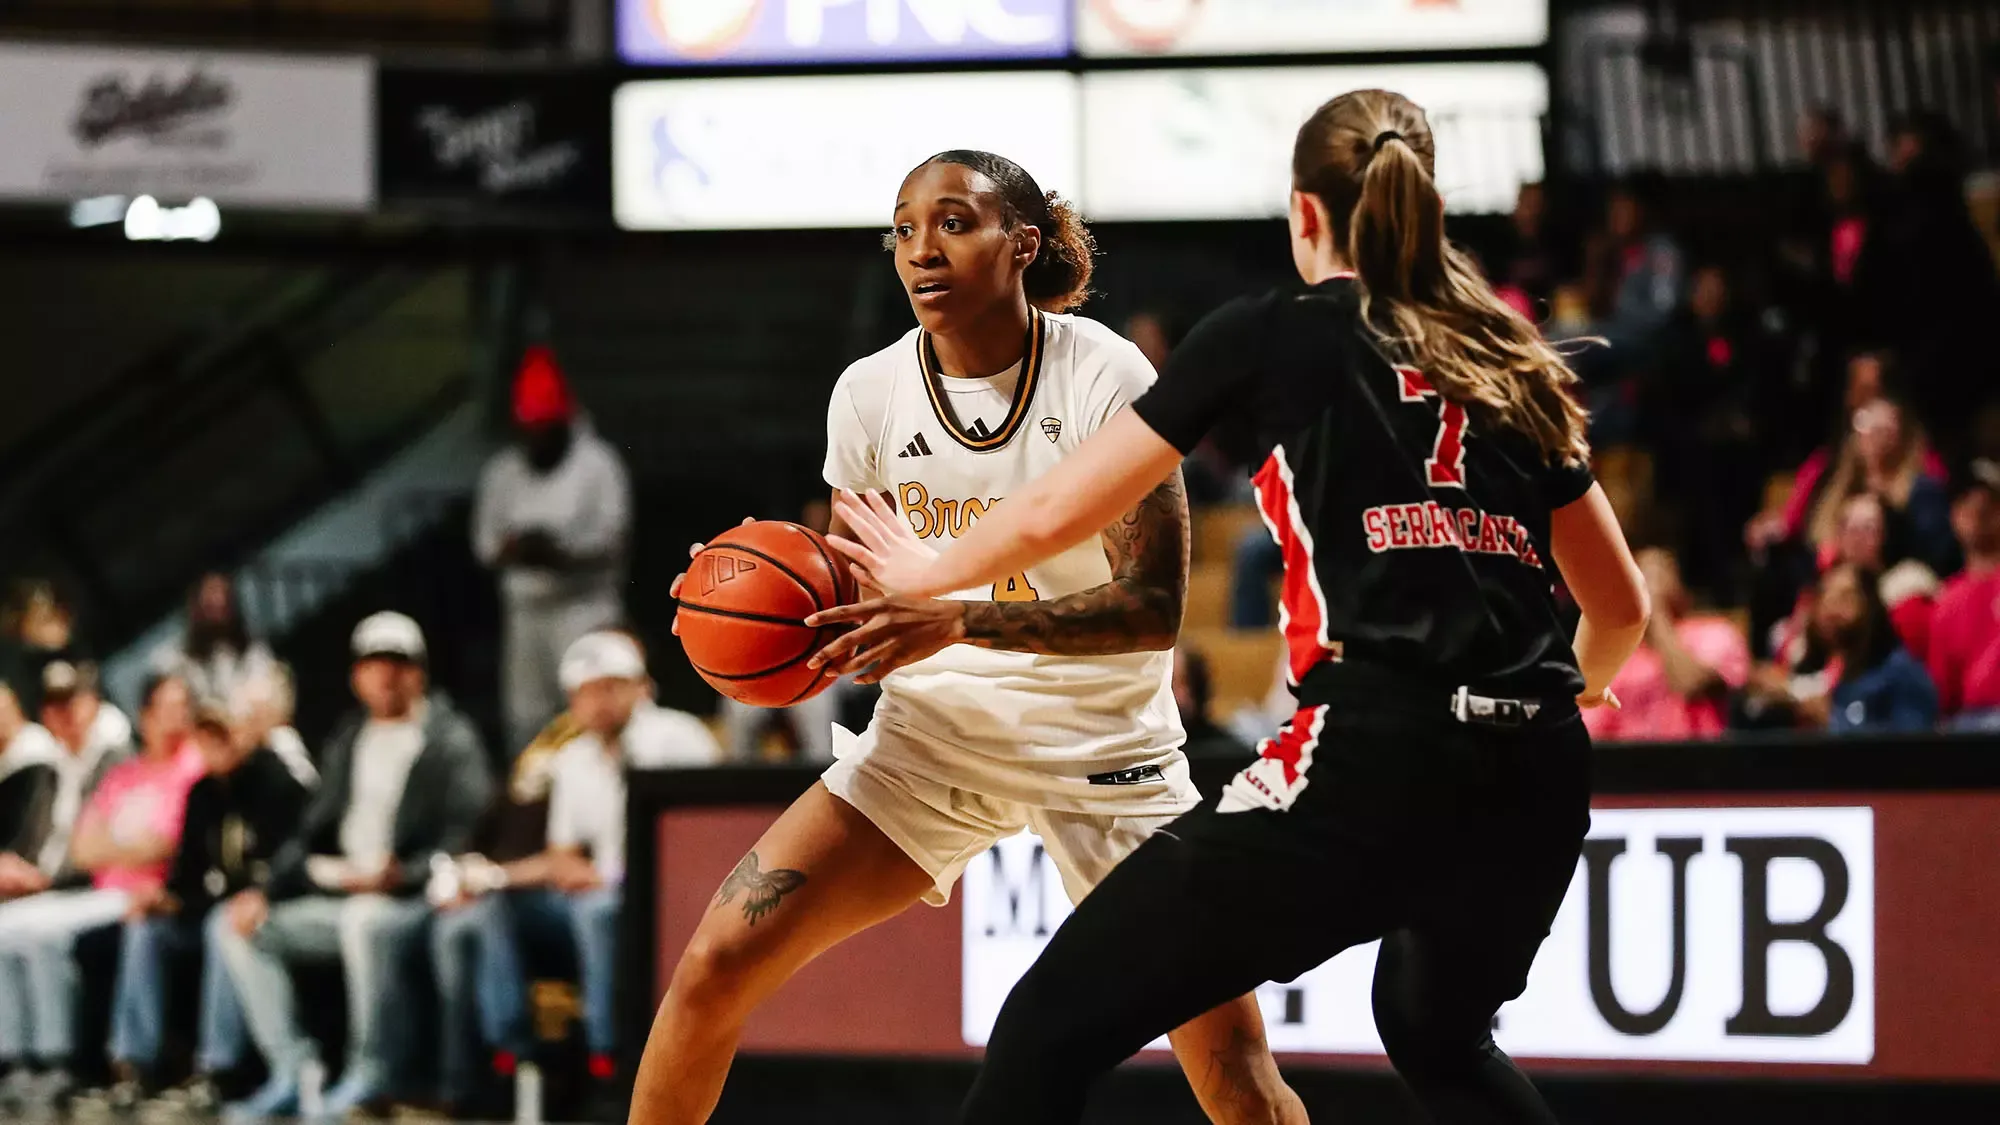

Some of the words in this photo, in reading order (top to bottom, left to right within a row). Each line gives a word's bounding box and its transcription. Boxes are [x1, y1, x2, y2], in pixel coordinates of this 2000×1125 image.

[1391, 363, 1470, 489] 7
[898, 481, 1005, 539] Bro
[1492, 836, 1854, 1036] UB
